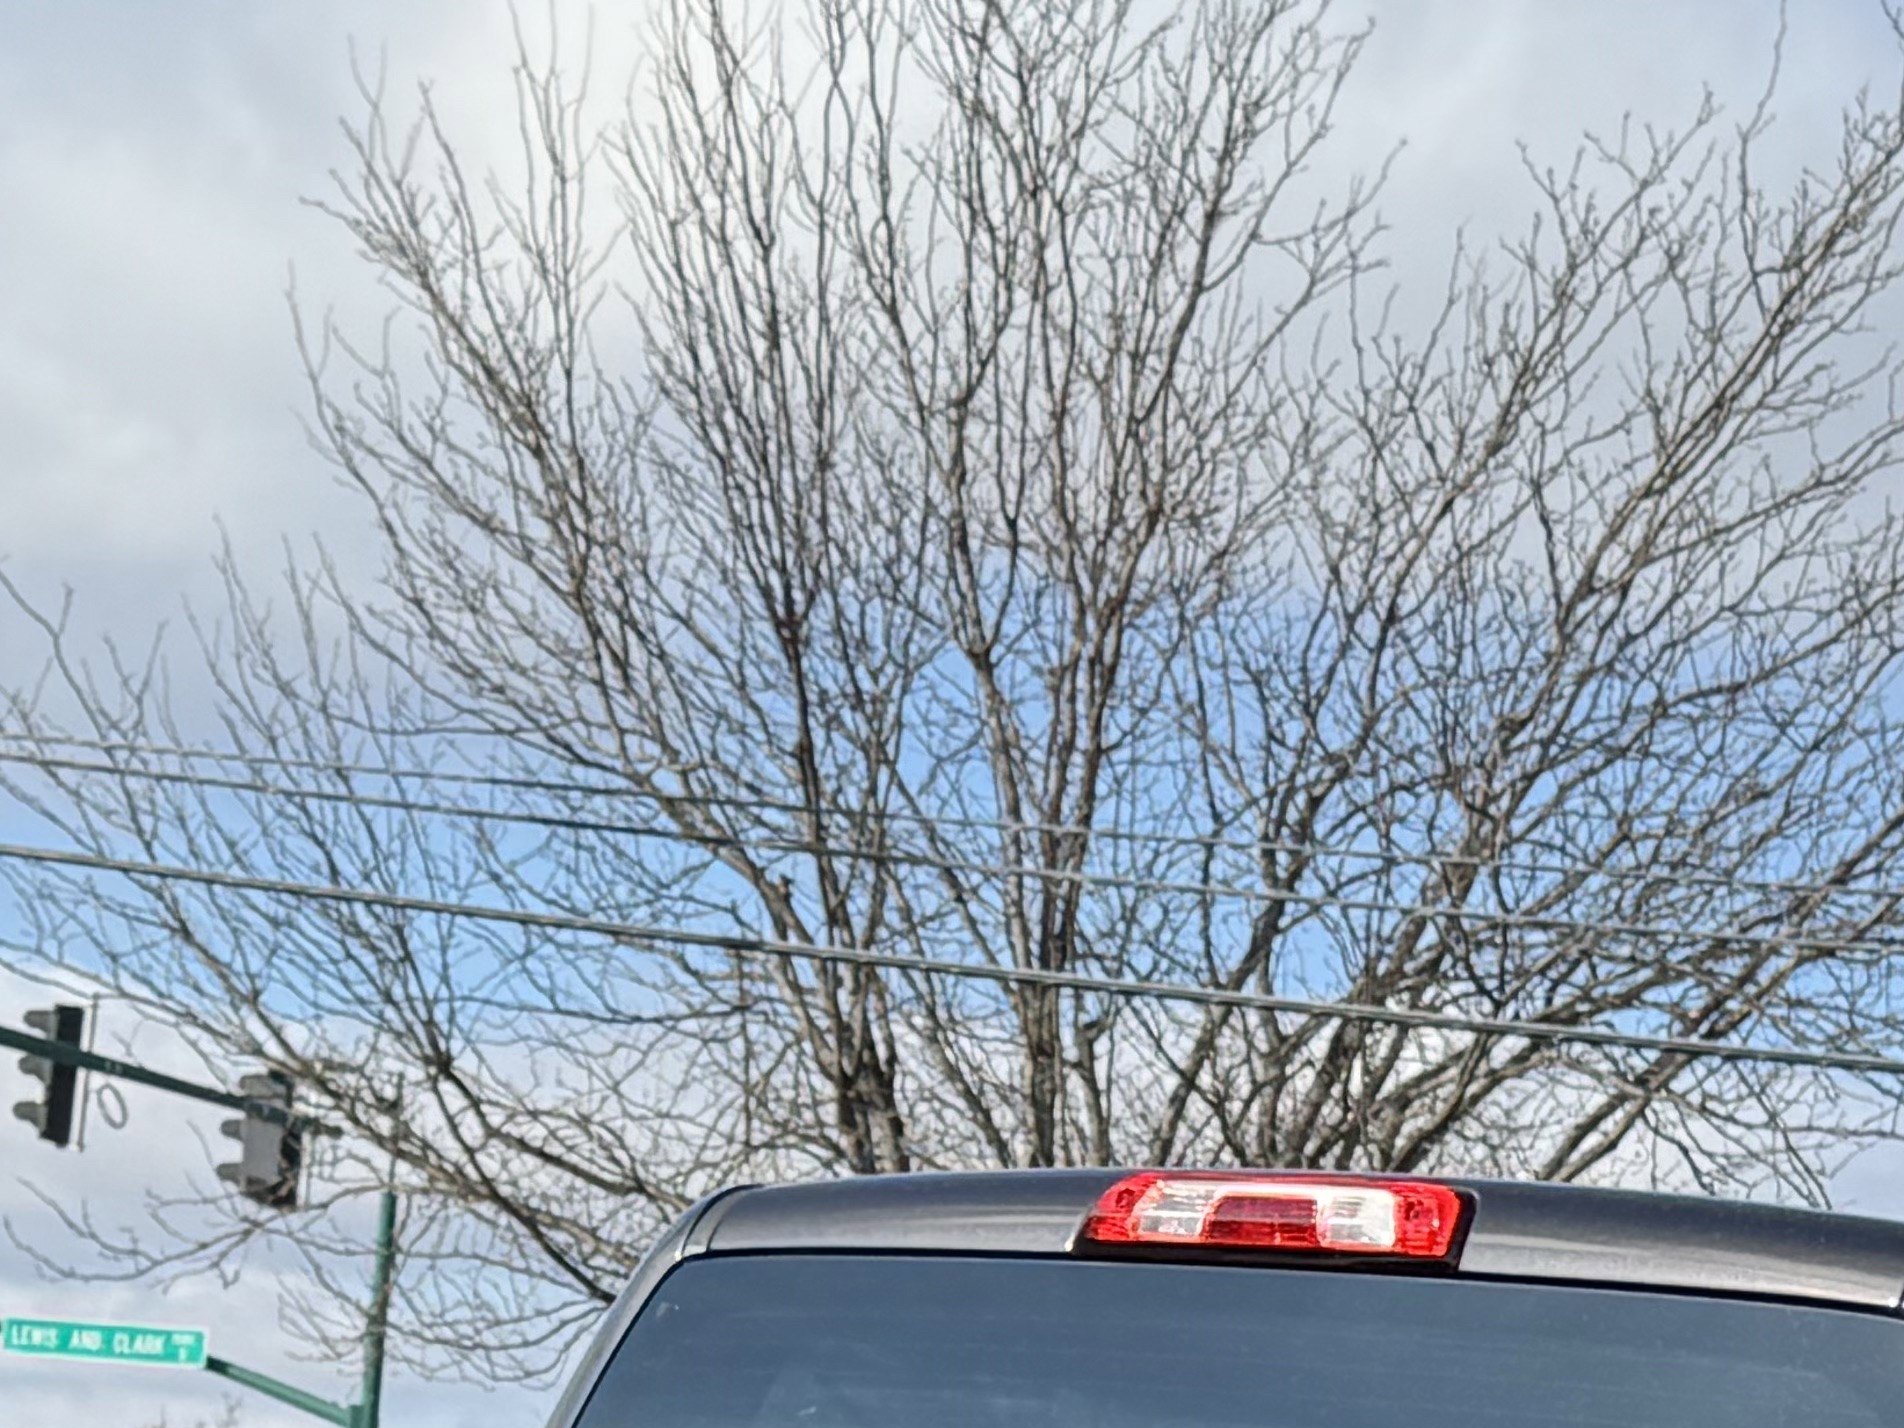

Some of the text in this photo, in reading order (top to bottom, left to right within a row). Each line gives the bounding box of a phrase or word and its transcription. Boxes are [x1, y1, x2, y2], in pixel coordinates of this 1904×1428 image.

[11, 1323, 59, 1348] LEWIS
[68, 1328, 103, 1351] AND
[112, 1331, 166, 1355] CLARK
